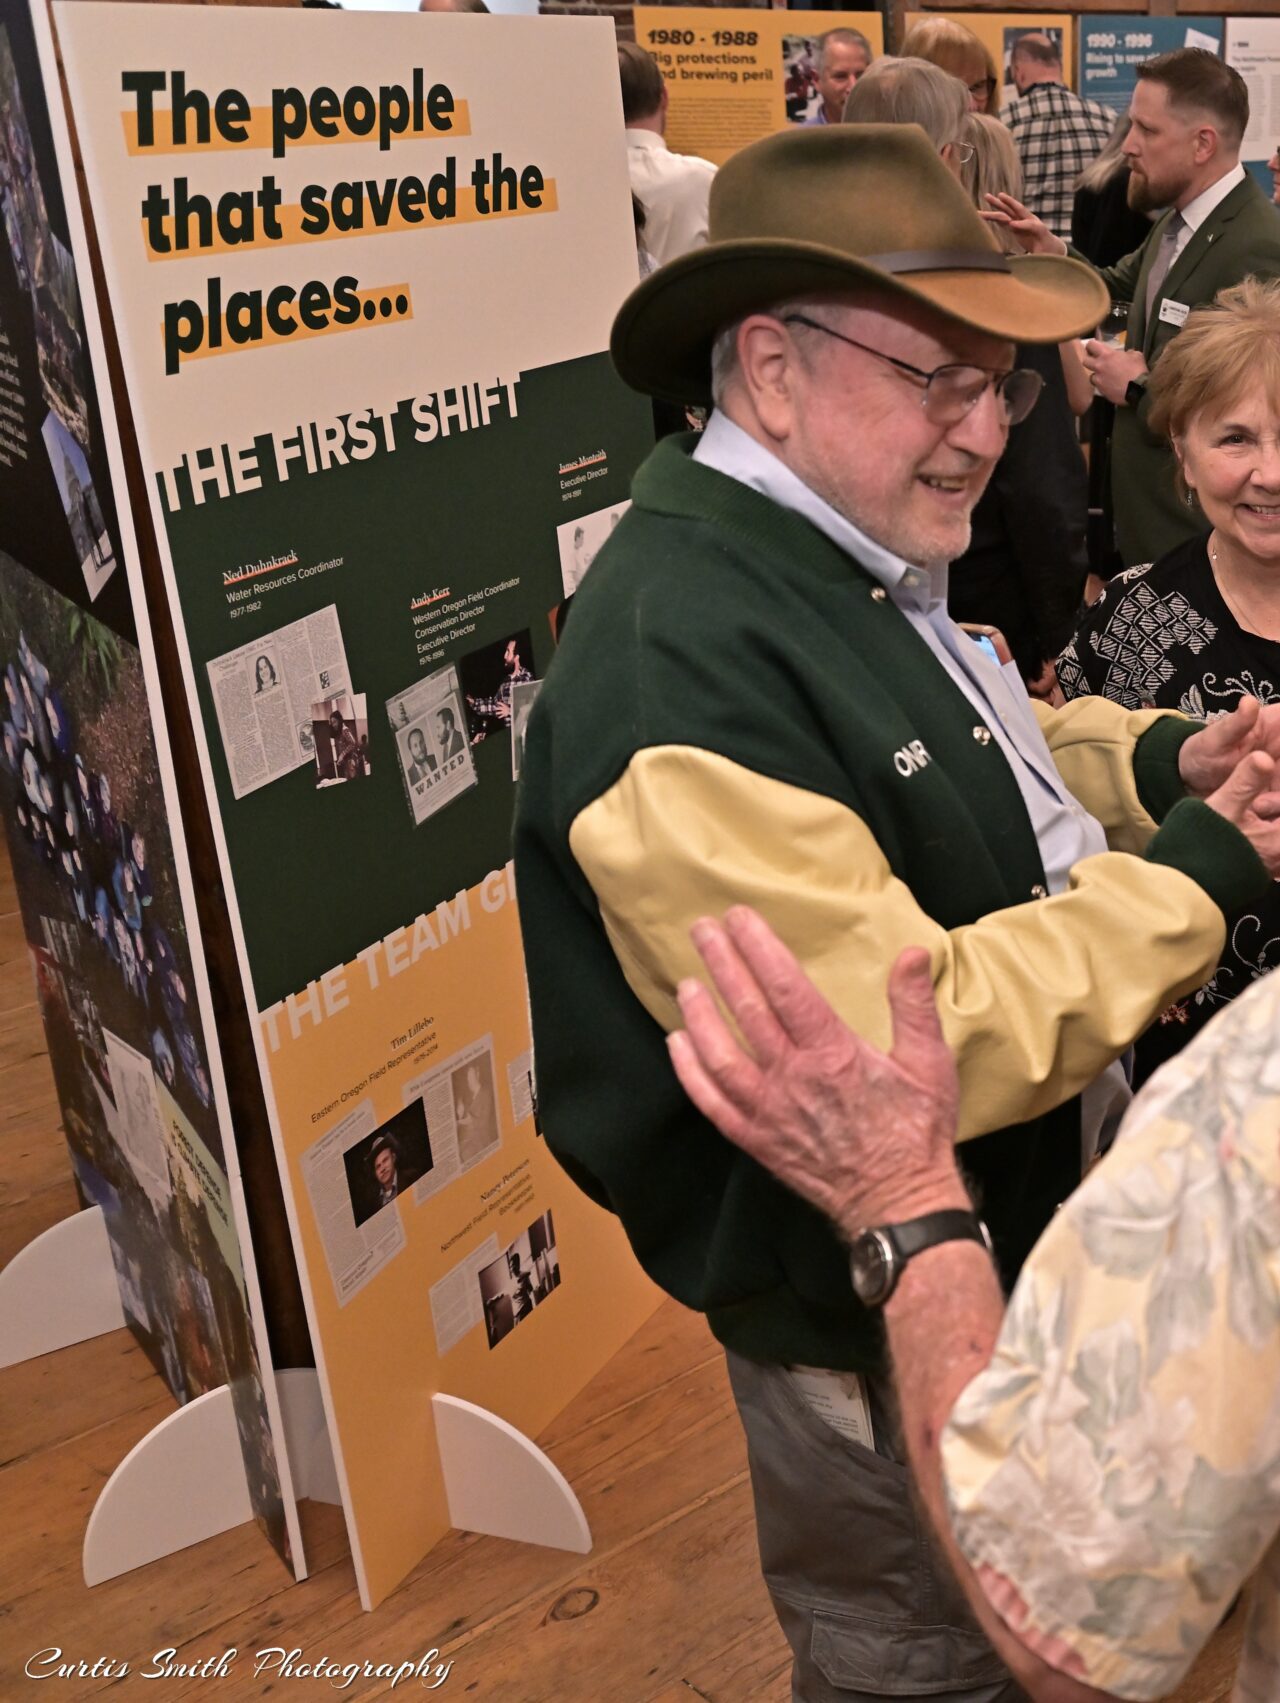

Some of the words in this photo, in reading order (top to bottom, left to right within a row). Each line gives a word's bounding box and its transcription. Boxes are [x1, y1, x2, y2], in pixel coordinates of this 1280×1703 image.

[647, 29, 695, 45] 1980
[712, 31, 759, 46] 1988
[677, 51, 757, 66] protections
[681, 68, 738, 83] brewing
[742, 68, 774, 83] peril
[121, 71, 251, 147] The
[272, 67, 455, 158] people
[141, 176, 283, 254] that
[300, 156, 457, 235] saved
[471, 152, 545, 214] the
[163, 275, 408, 376] places...
[154, 434, 263, 512] THE
[271, 402, 399, 482] FIRST
[411, 372, 521, 443] SHIFT
[560, 474, 587, 489] Executive
[587, 467, 609, 480] Director
[222, 566, 243, 582] Ned
[245, 549, 299, 577] Duhnkrack
[226, 587, 252, 604] Water
[253, 573, 297, 595] Resources
[297, 556, 344, 580] Coordinator
[230, 601, 262, 619] 1977-1982
[411, 592, 431, 608] Andy
[431, 587, 451, 600] Kerr
[412, 608, 441, 626] Western
[441, 598, 467, 614] Oregon
[467, 590, 484, 603] Field
[484, 577, 520, 597] Coordinator
[414, 615, 459, 639] Conservation
[460, 605, 485, 621] Director
[416, 634, 449, 654] Executive
[450, 623, 476, 640] Director
[415, 754, 465, 796] WANTED
[257, 962, 350, 1053] THE
[356, 888, 472, 991] TEAM
[390, 1034, 408, 1050] Tim
[311, 1100, 339, 1123] Eastern
[340, 1079, 368, 1103] Oregon
[368, 1066, 387, 1082] Field
[387, 1032, 437, 1069] Representative
